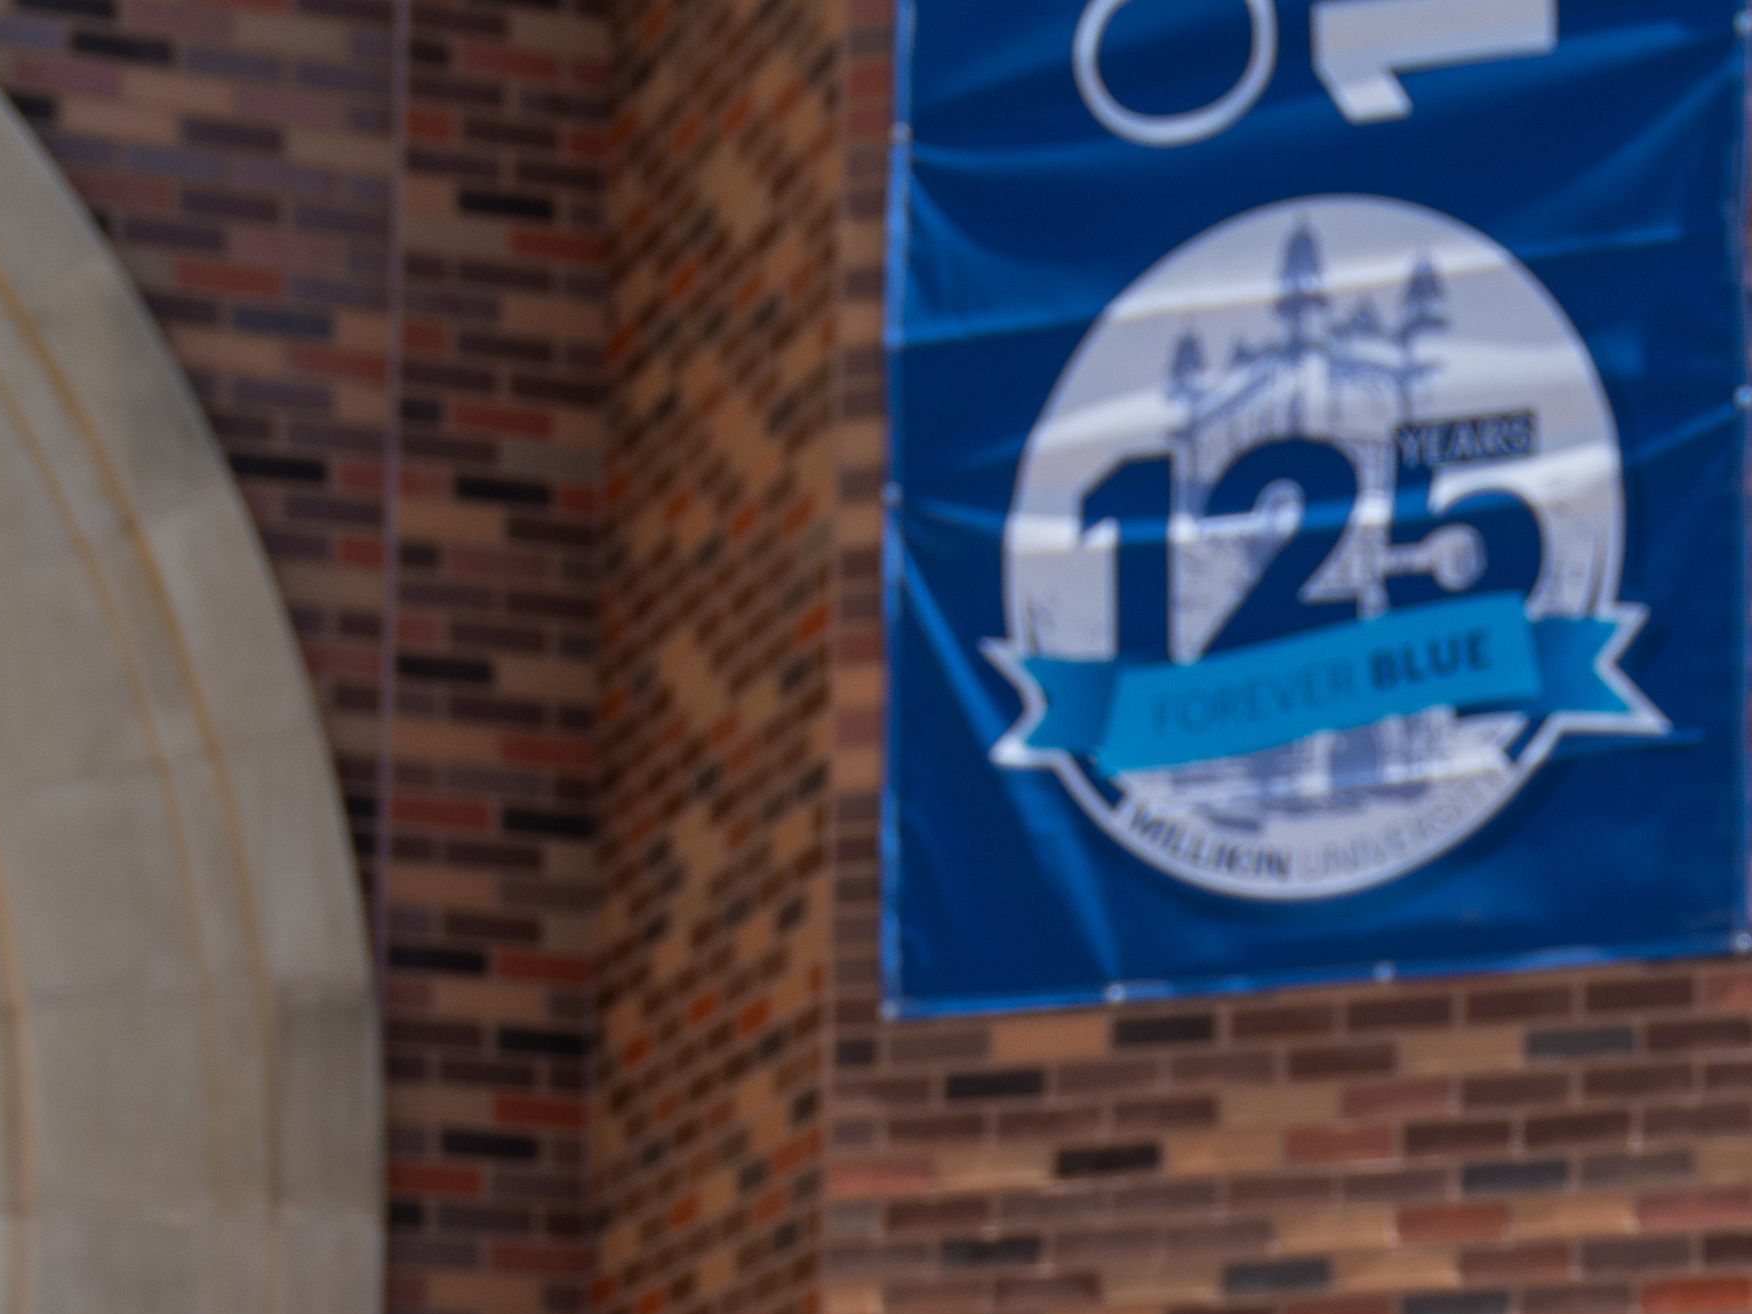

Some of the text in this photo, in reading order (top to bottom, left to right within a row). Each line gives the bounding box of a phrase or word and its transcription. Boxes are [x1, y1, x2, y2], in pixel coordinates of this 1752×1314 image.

[1399, 414, 1534, 468] YEARS
[1081, 434, 1544, 664] 125
[1153, 628, 1491, 740] FOREVER BLUE
